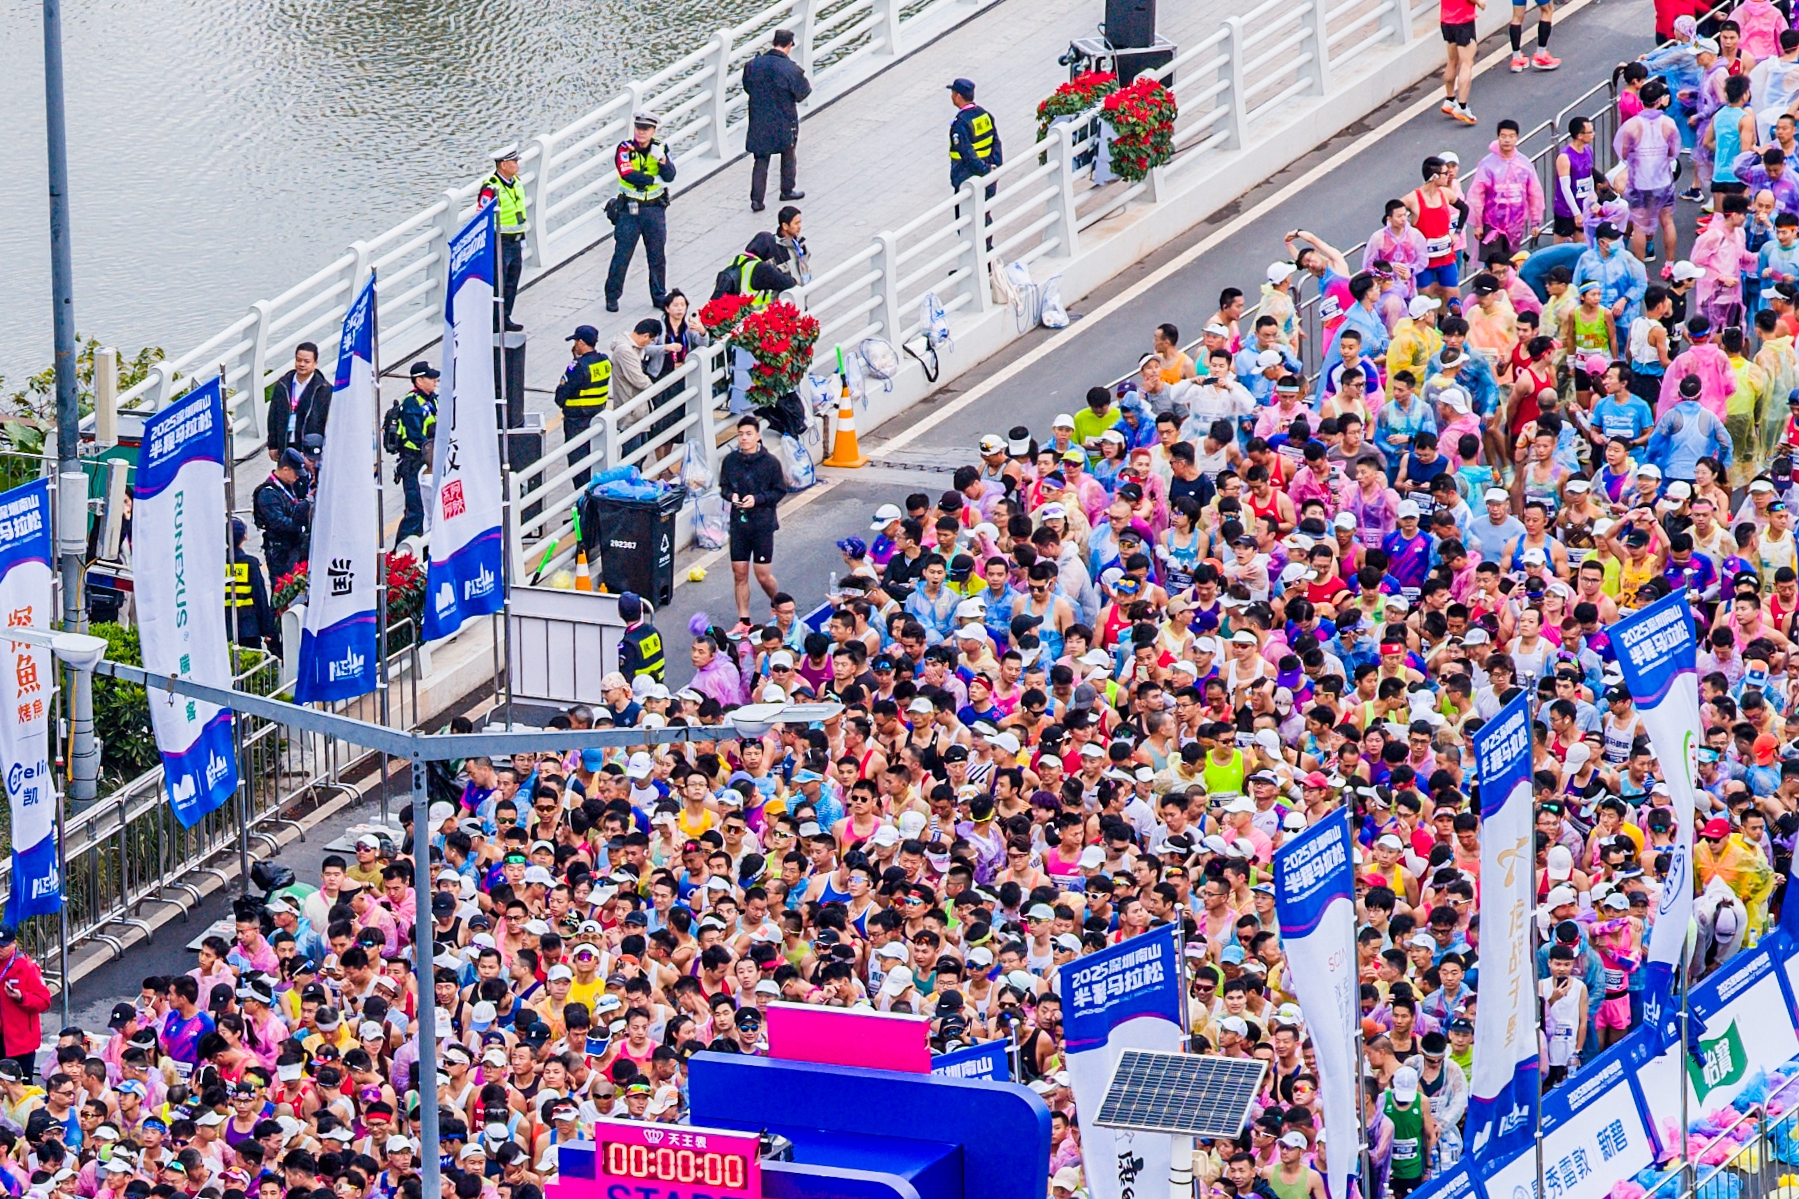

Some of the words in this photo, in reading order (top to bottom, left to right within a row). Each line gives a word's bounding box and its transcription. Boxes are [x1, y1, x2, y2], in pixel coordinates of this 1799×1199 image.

[174, 490, 189, 628] RUNEXUS
[1071, 942, 1162, 987] 2025深圳南山
[1073, 964, 1164, 1008] 半程马拉松
[668, 1133, 707, 1149] 天王表
[609, 1143, 743, 1188] 00:00:00
